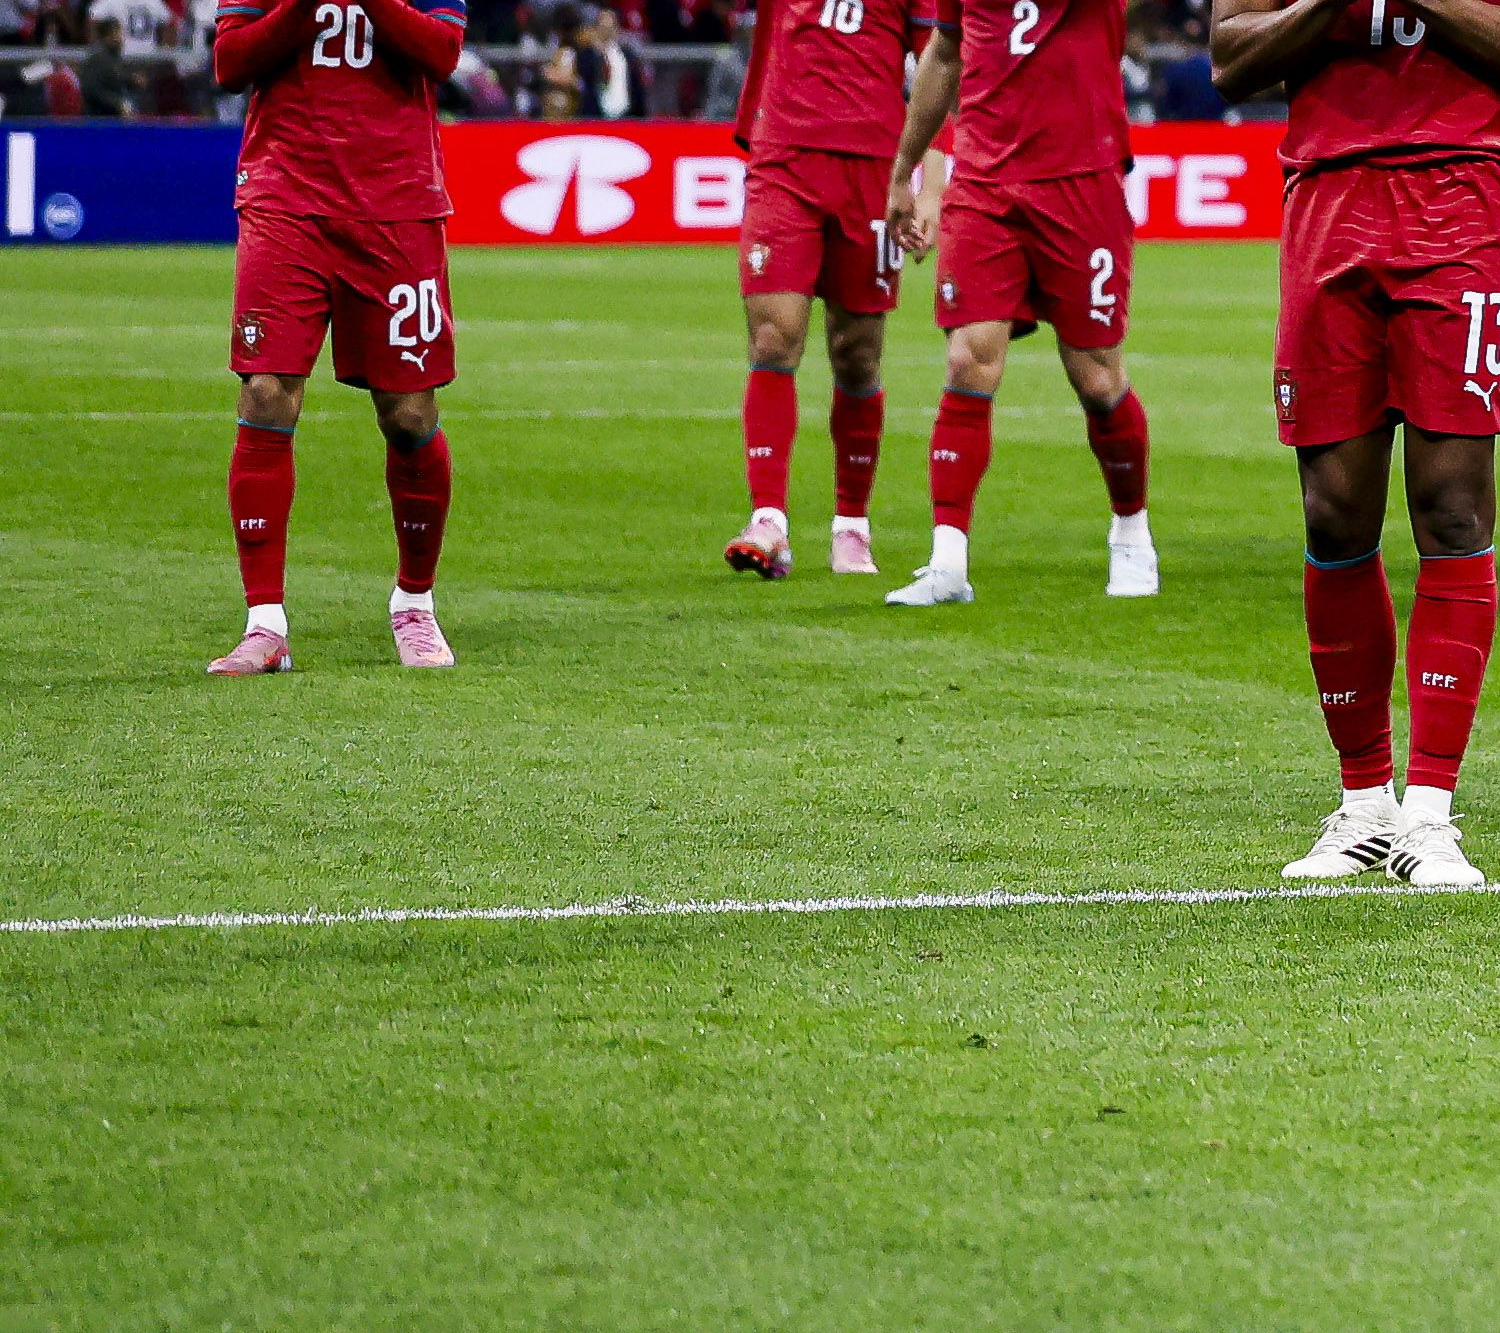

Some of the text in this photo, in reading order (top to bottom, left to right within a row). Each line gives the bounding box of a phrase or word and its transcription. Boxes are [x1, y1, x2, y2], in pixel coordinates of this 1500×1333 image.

[313, 3, 374, 69] 20
[1009, 0, 1039, 56] 2
[1089, 247, 1115, 307] 2
[389, 279, 442, 347] 20
